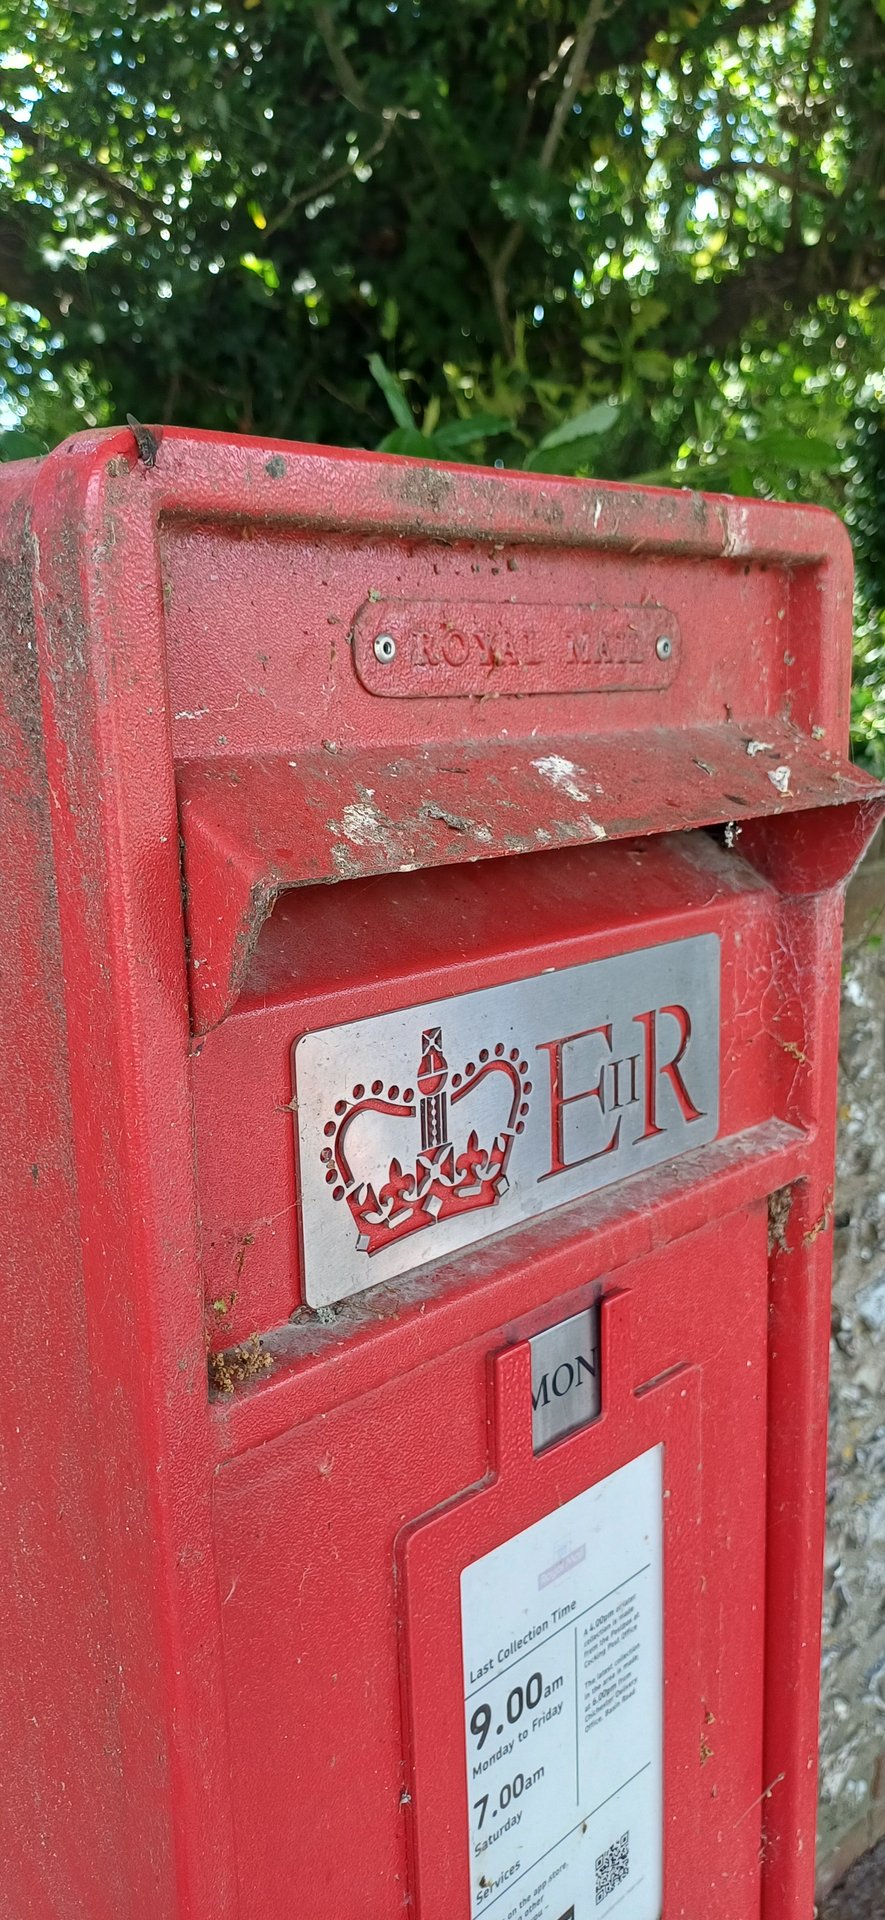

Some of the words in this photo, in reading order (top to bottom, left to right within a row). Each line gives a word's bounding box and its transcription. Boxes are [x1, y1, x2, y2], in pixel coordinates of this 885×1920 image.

[412, 627, 544, 667] ROYAL
[566, 631, 644, 665] MAIL
[470, 1659, 494, 1684] Last
[497, 1620, 549, 1664] Collection
[551, 1600, 577, 1624] Time
[470, 1672, 564, 1750] 9.00am
[472, 1739, 515, 1779] Monday
[518, 1729, 529, 1742] to
[532, 1701, 564, 1732] Friday
[473, 1766, 545, 1830] 7.00am
[475, 1810, 522, 1857] Saturday
[476, 1860, 521, 1905] Services
[507, 1907, 518, 1920] on
[519, 1894, 532, 1909] the
[533, 1880, 547, 1897] app
[524, 1894, 544, 1917] other
